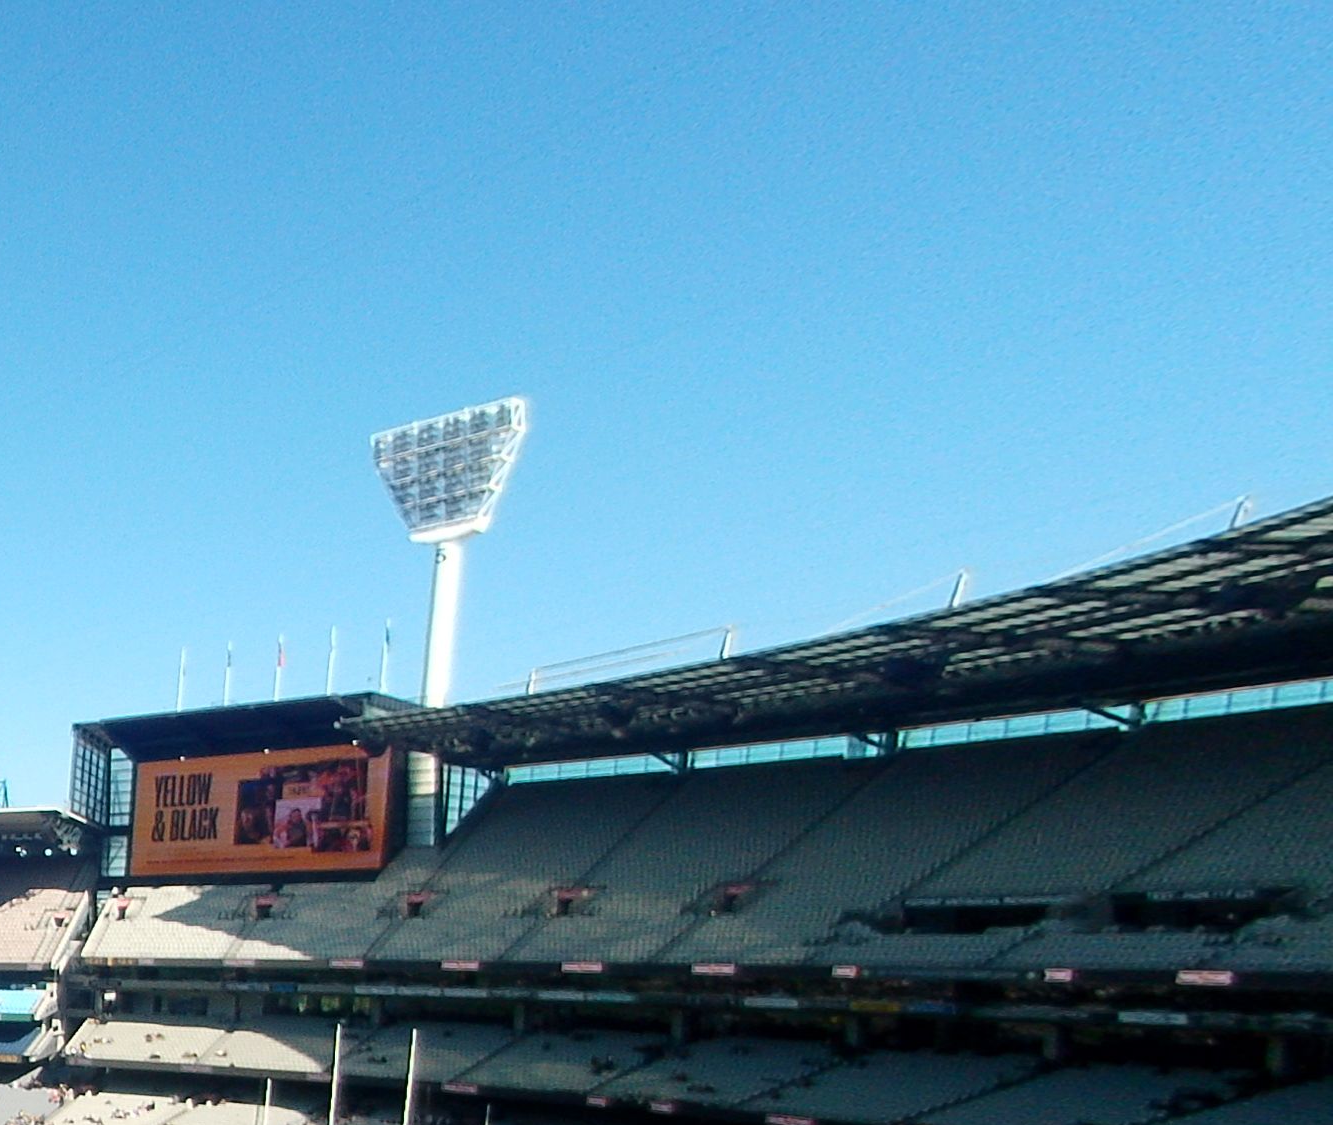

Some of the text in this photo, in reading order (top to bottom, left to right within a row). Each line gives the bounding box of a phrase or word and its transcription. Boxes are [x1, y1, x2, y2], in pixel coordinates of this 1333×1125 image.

[155, 773, 213, 807] YELLOW
[152, 807, 219, 842] & BLACK
